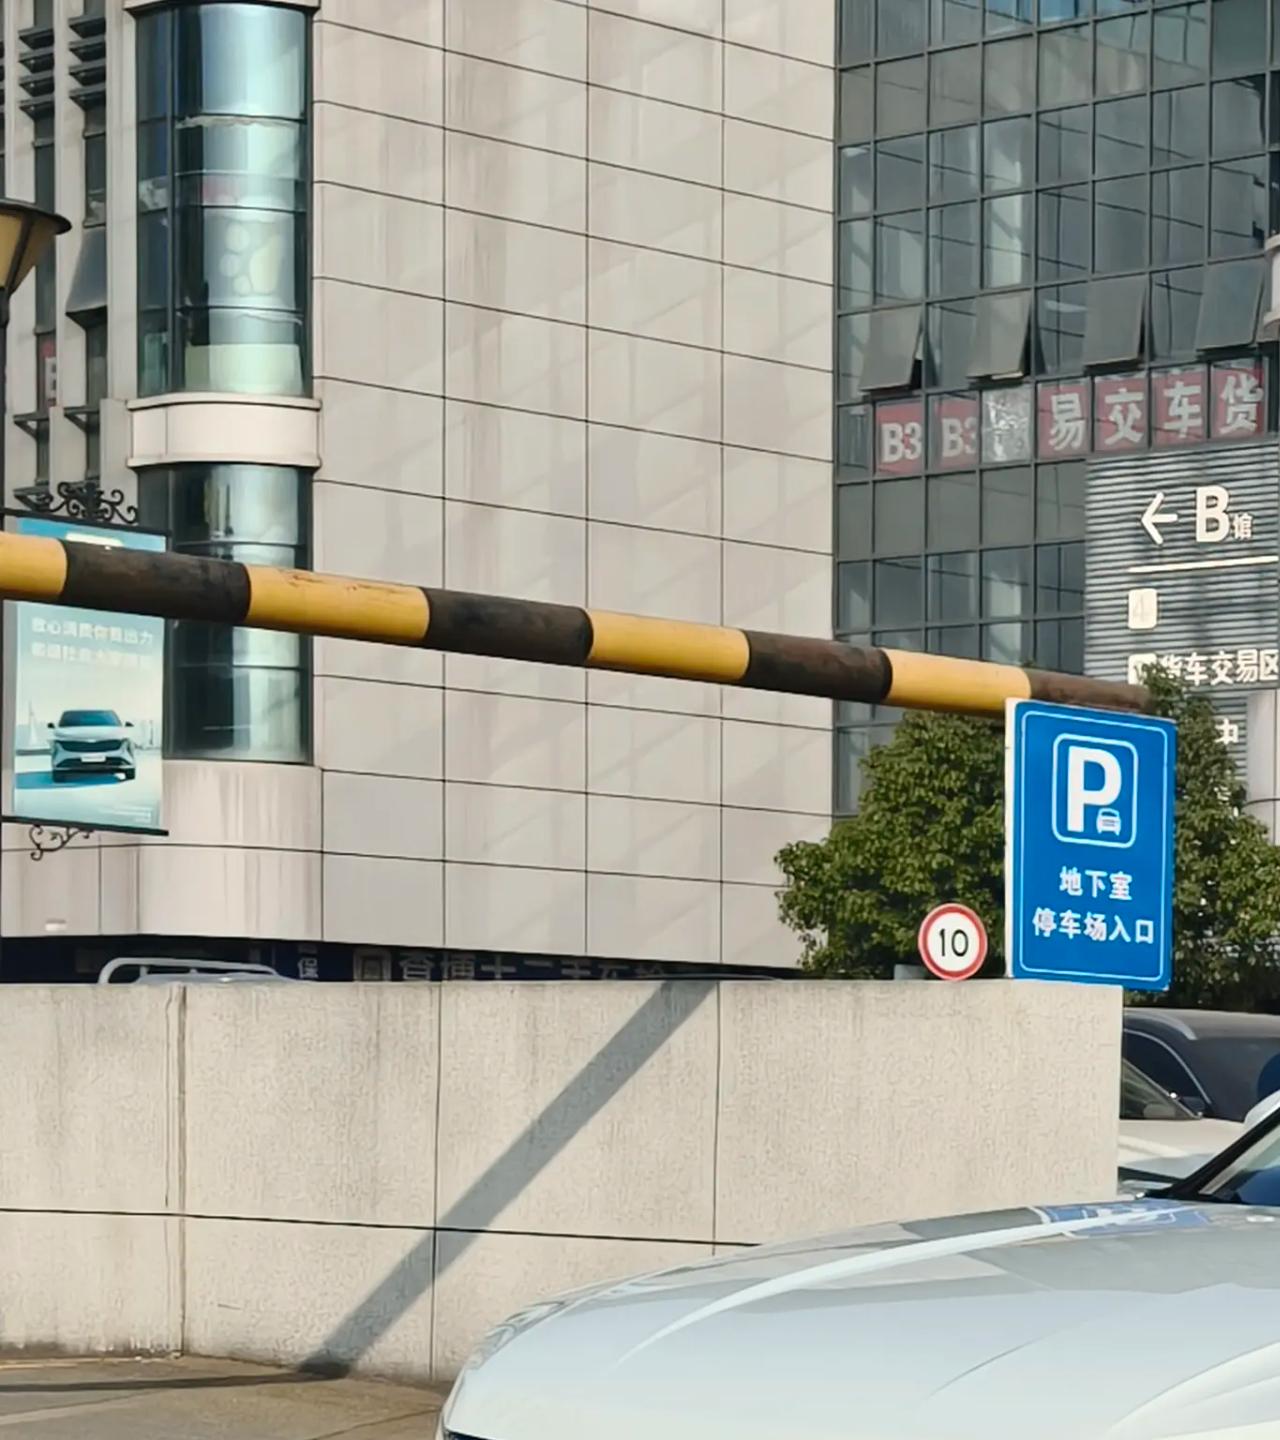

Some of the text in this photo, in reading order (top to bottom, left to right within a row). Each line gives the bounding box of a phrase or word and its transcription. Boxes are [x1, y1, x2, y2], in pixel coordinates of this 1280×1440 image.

[1065, 745, 1123, 834] P
[1059, 865, 1133, 902] 地下室
[937, 927, 970, 959] 10
[1031, 905, 1155, 946] 停车场入口
